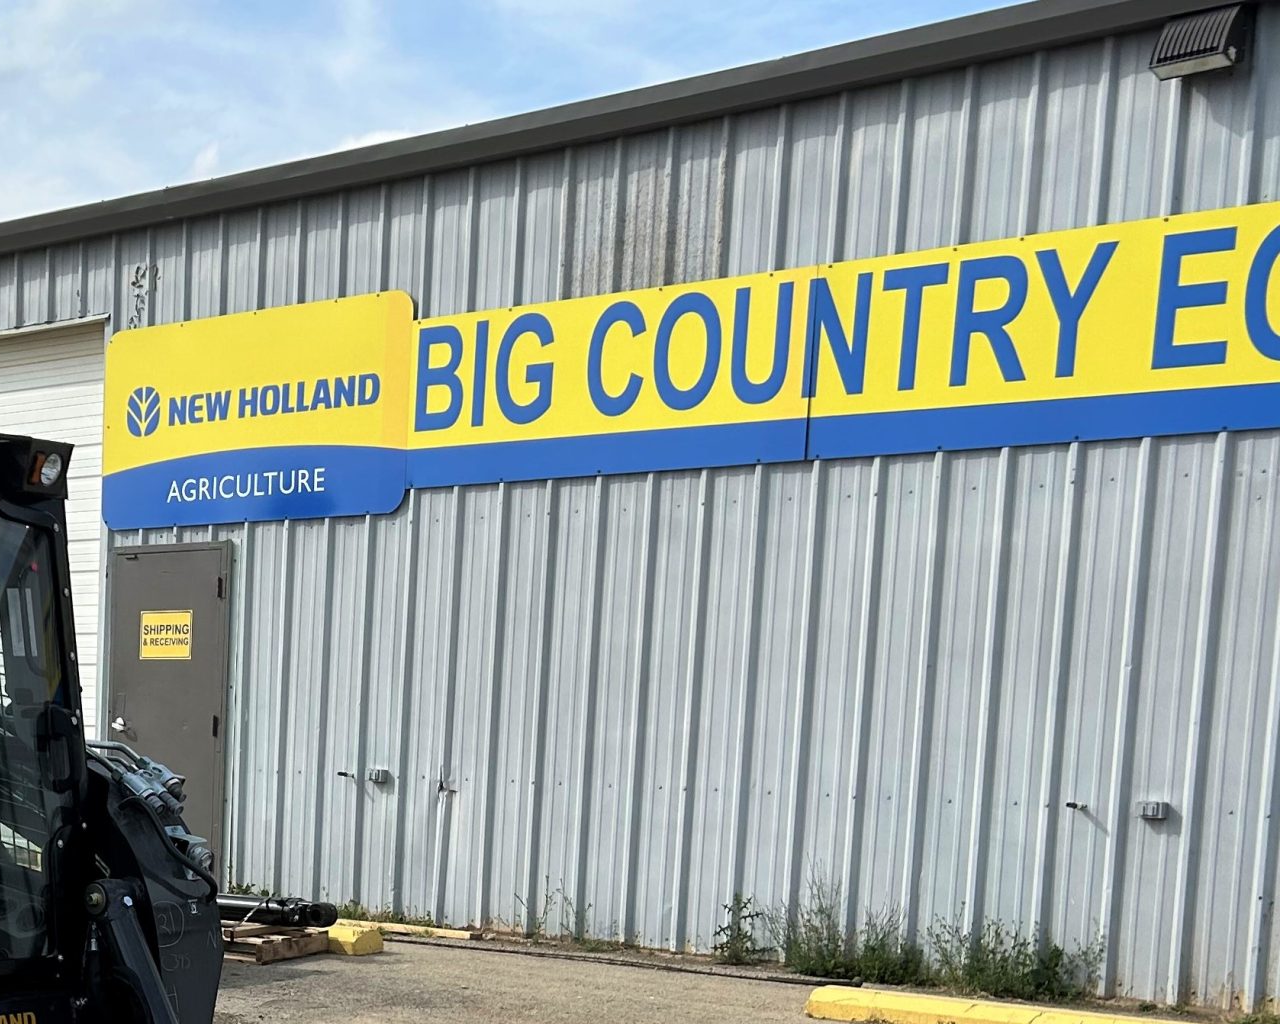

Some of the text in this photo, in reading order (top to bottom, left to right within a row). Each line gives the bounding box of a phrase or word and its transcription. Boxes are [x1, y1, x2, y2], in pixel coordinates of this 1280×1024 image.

[415, 314, 554, 432] BIG
[588, 242, 1118, 417] COUNTRY
[168, 373, 380, 427] NEW HOLLAND
[167, 467, 326, 504] AGRICULTURE
[143, 624, 189, 635] SHIPPING
[143, 637, 189, 646] & RECEIVING
